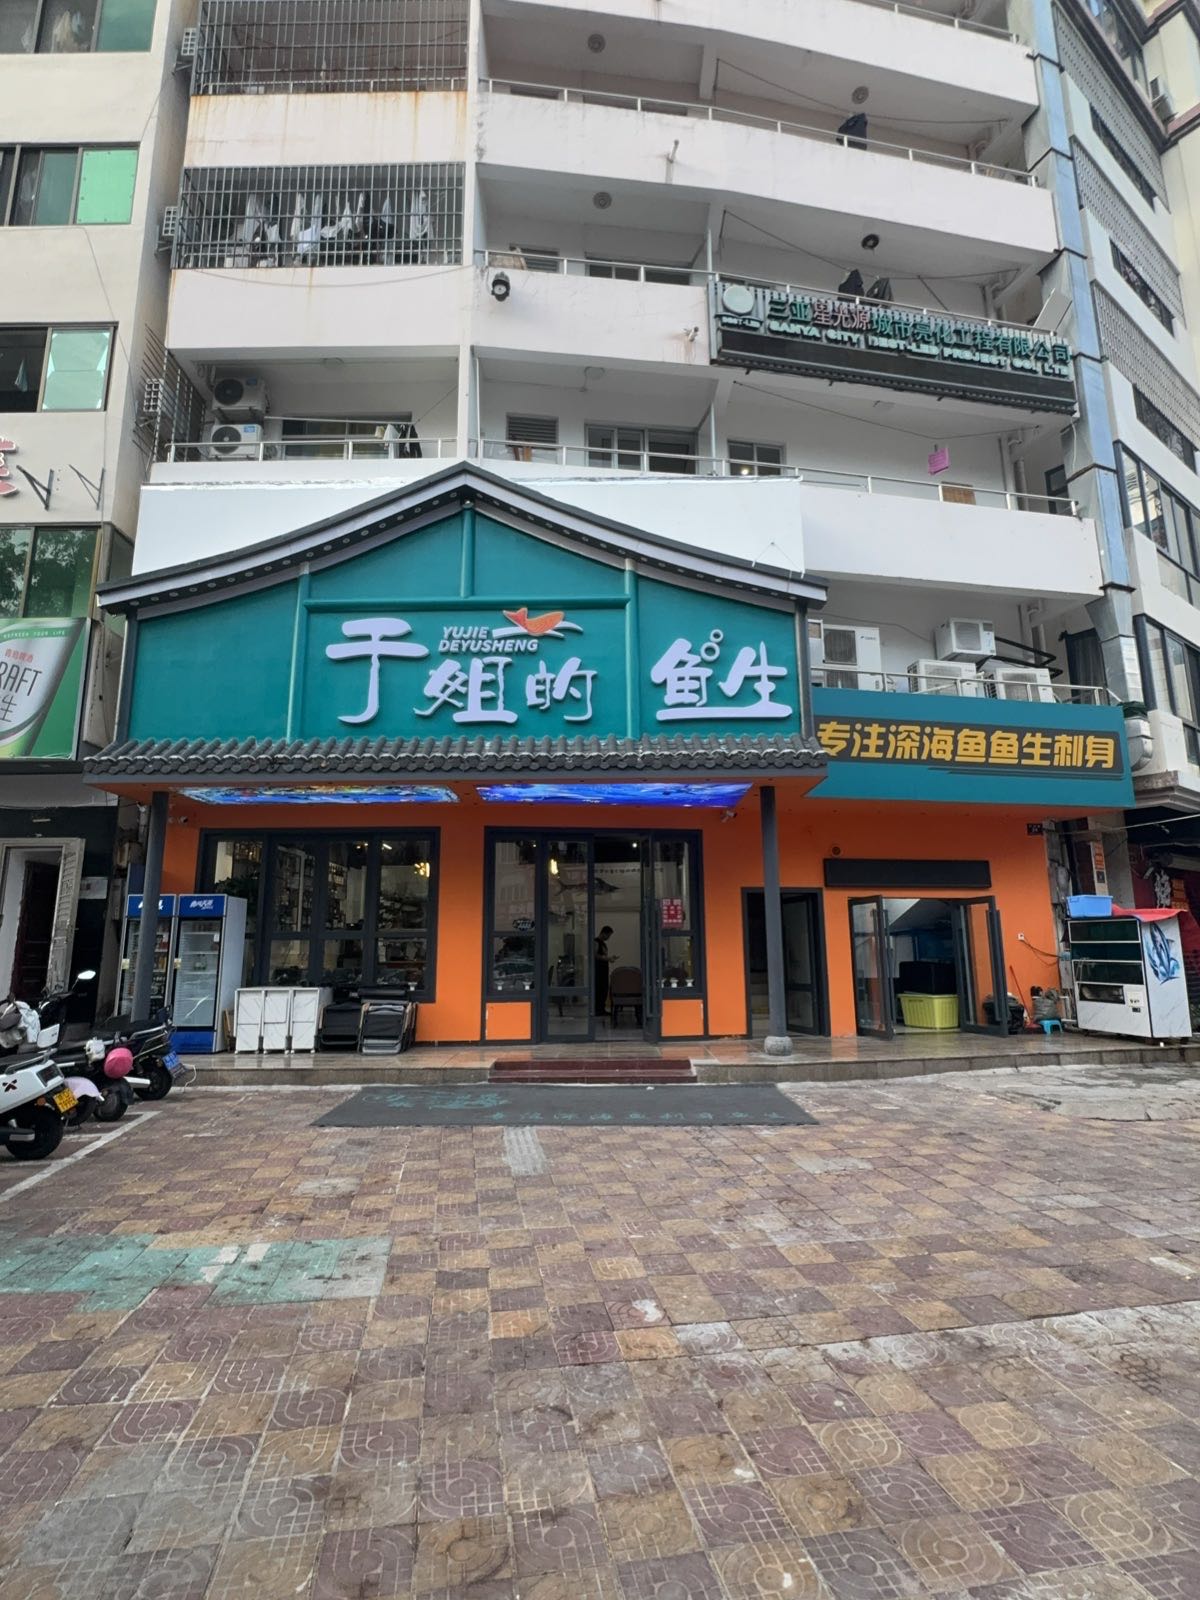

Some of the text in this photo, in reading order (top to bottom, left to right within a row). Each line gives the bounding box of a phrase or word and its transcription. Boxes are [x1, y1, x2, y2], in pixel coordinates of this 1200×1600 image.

[768, 320, 820, 338] SANYA
[826, 330, 860, 344] CITY
[943, 348, 1007, 366] PROJECT
[438, 639, 538, 653] DEYUSHENG
[443, 626, 489, 640] YUJIE
[815, 721, 1115, 769] 专注深海鱼鱼生刺身
